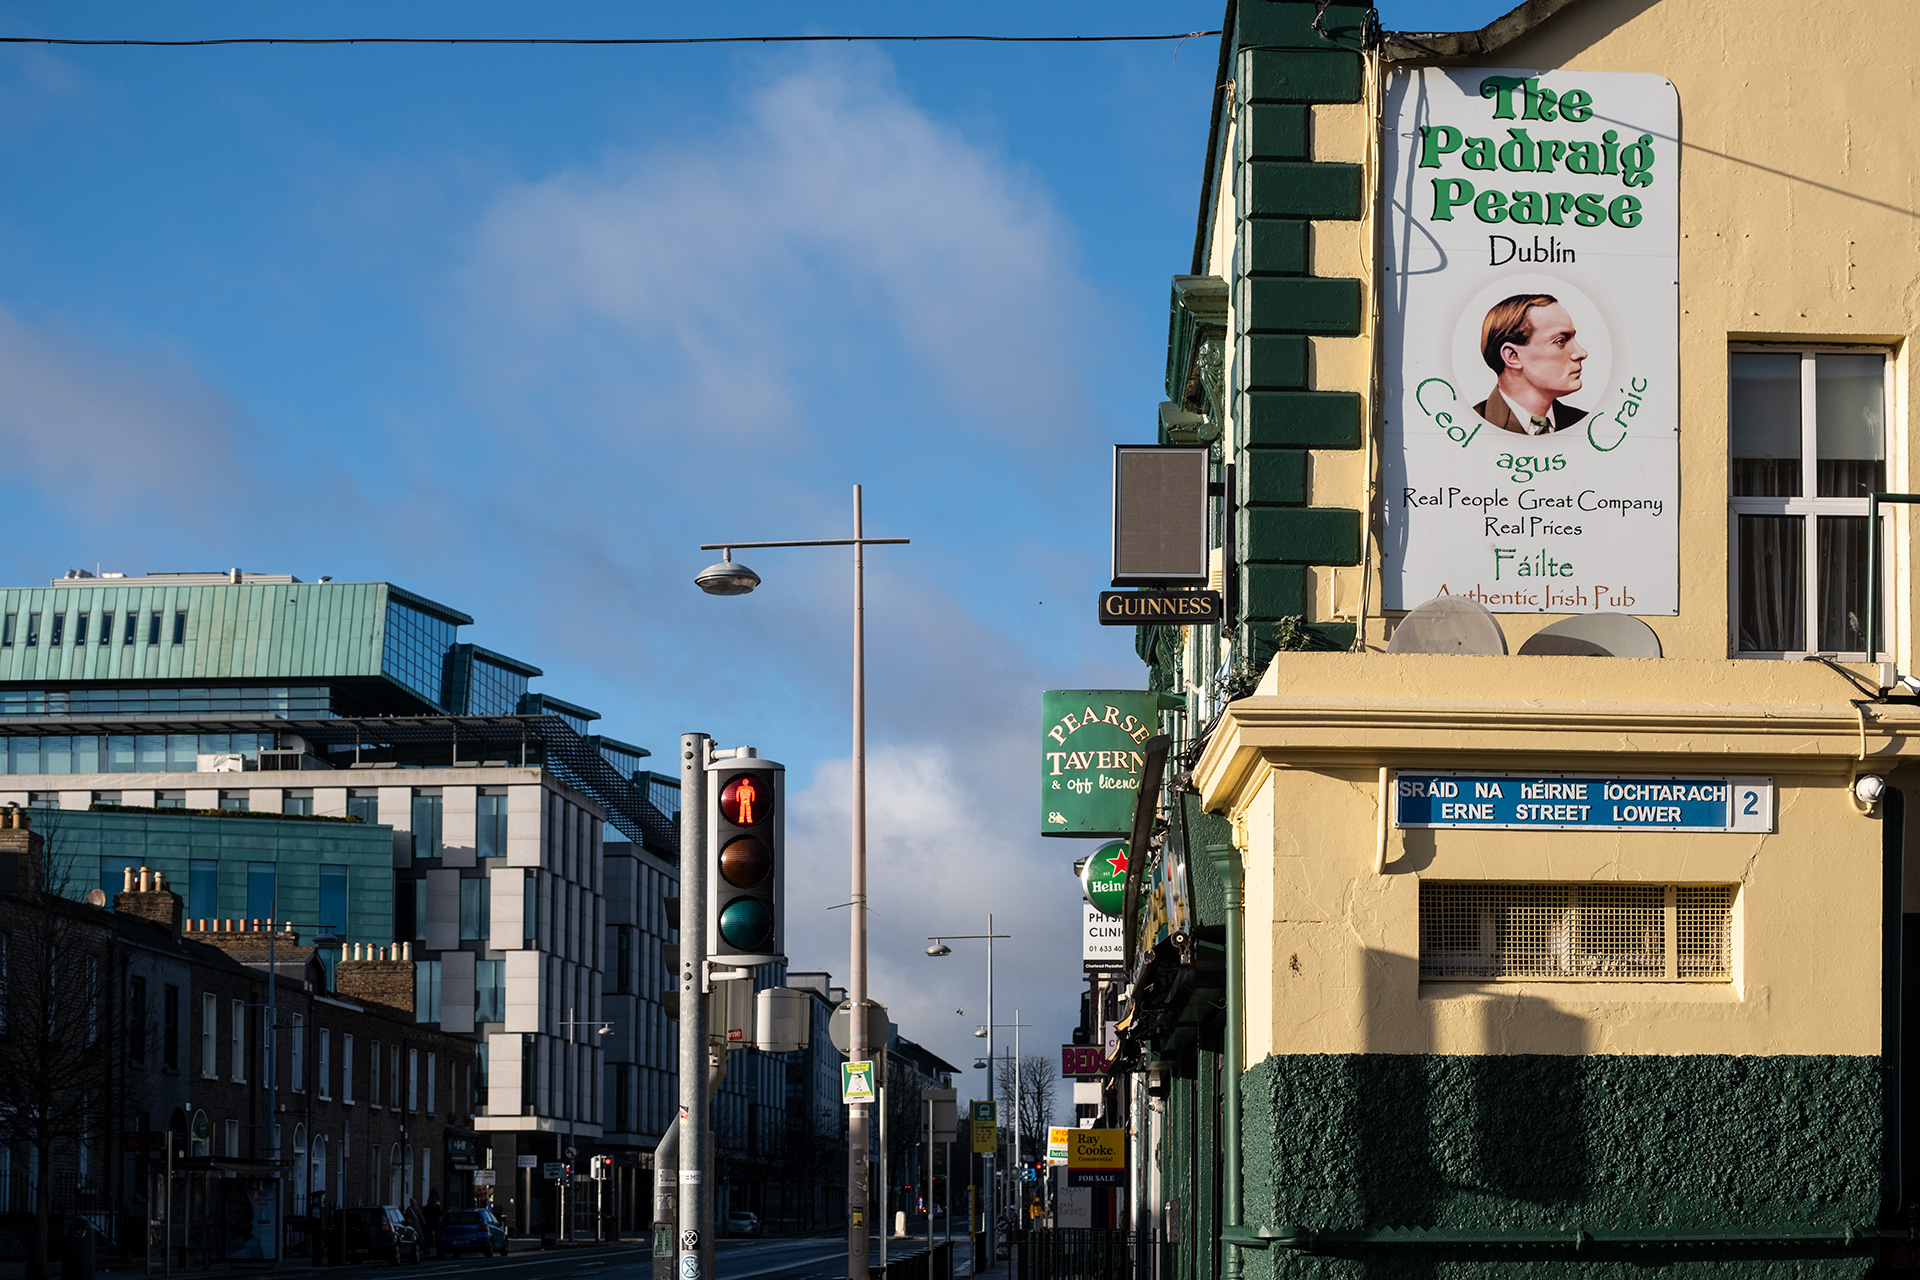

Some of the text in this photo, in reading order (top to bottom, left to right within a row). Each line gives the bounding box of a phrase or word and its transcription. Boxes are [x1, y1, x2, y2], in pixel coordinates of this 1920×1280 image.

[1480, 75, 1593, 122] The
[1418, 125, 1655, 187] Padraig
[1430, 177, 1643, 228] Pearse
[1489, 235, 1576, 266] Dublin
[1416, 377, 1483, 448] Ceol
[1587, 377, 1648, 452] Craic
[1496, 452, 1567, 483] agus
[1402, 487, 1664, 517] Real People Great Company
[1485, 516, 1583, 537] Real Prices
[1494, 548, 1574, 581] Fáilte
[1106, 595, 1212, 616] GUINNESS
[1436, 584, 1636, 609] Athentic Irish Pub
[1047, 705, 1150, 746] PEARSE
[1046, 751, 1144, 776] TAVERN
[1051, 780, 1062, 790] &
[1399, 779, 1758, 815] SRÁID NA hÉIRNE ÍOCHTARACH 2
[1441, 804, 1684, 823] ERNE STREET LOWER
[1089, 927, 1123, 937] CLINI
[1062, 1048, 1111, 1073] BEDS
[1078, 1134, 1100, 1146] Ray
